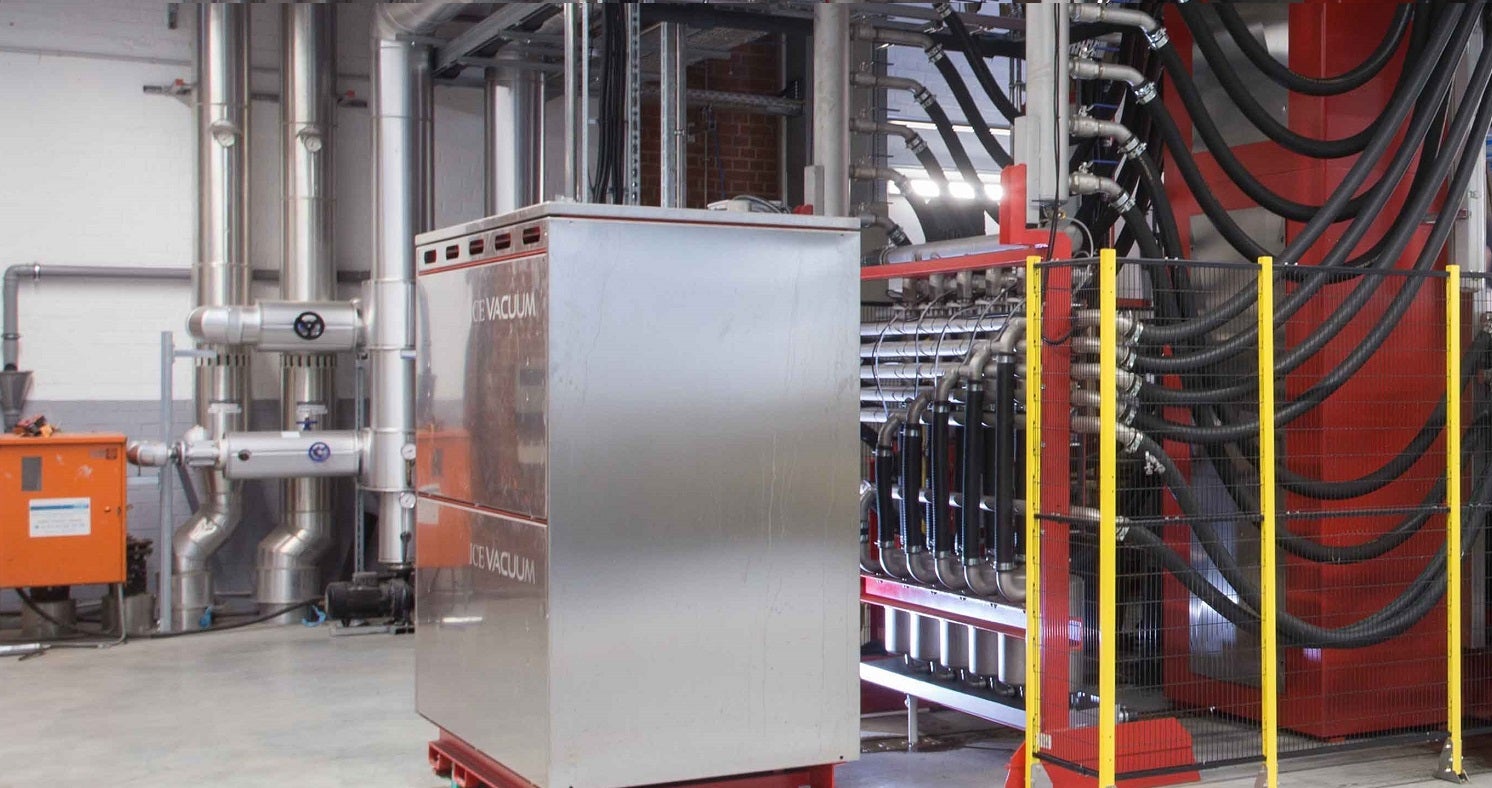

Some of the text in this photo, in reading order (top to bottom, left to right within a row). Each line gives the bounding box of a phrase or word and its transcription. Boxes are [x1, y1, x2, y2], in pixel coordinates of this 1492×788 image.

[469, 290, 536, 322] CE VACUUM
[469, 543, 536, 585] ICE VACUUM
